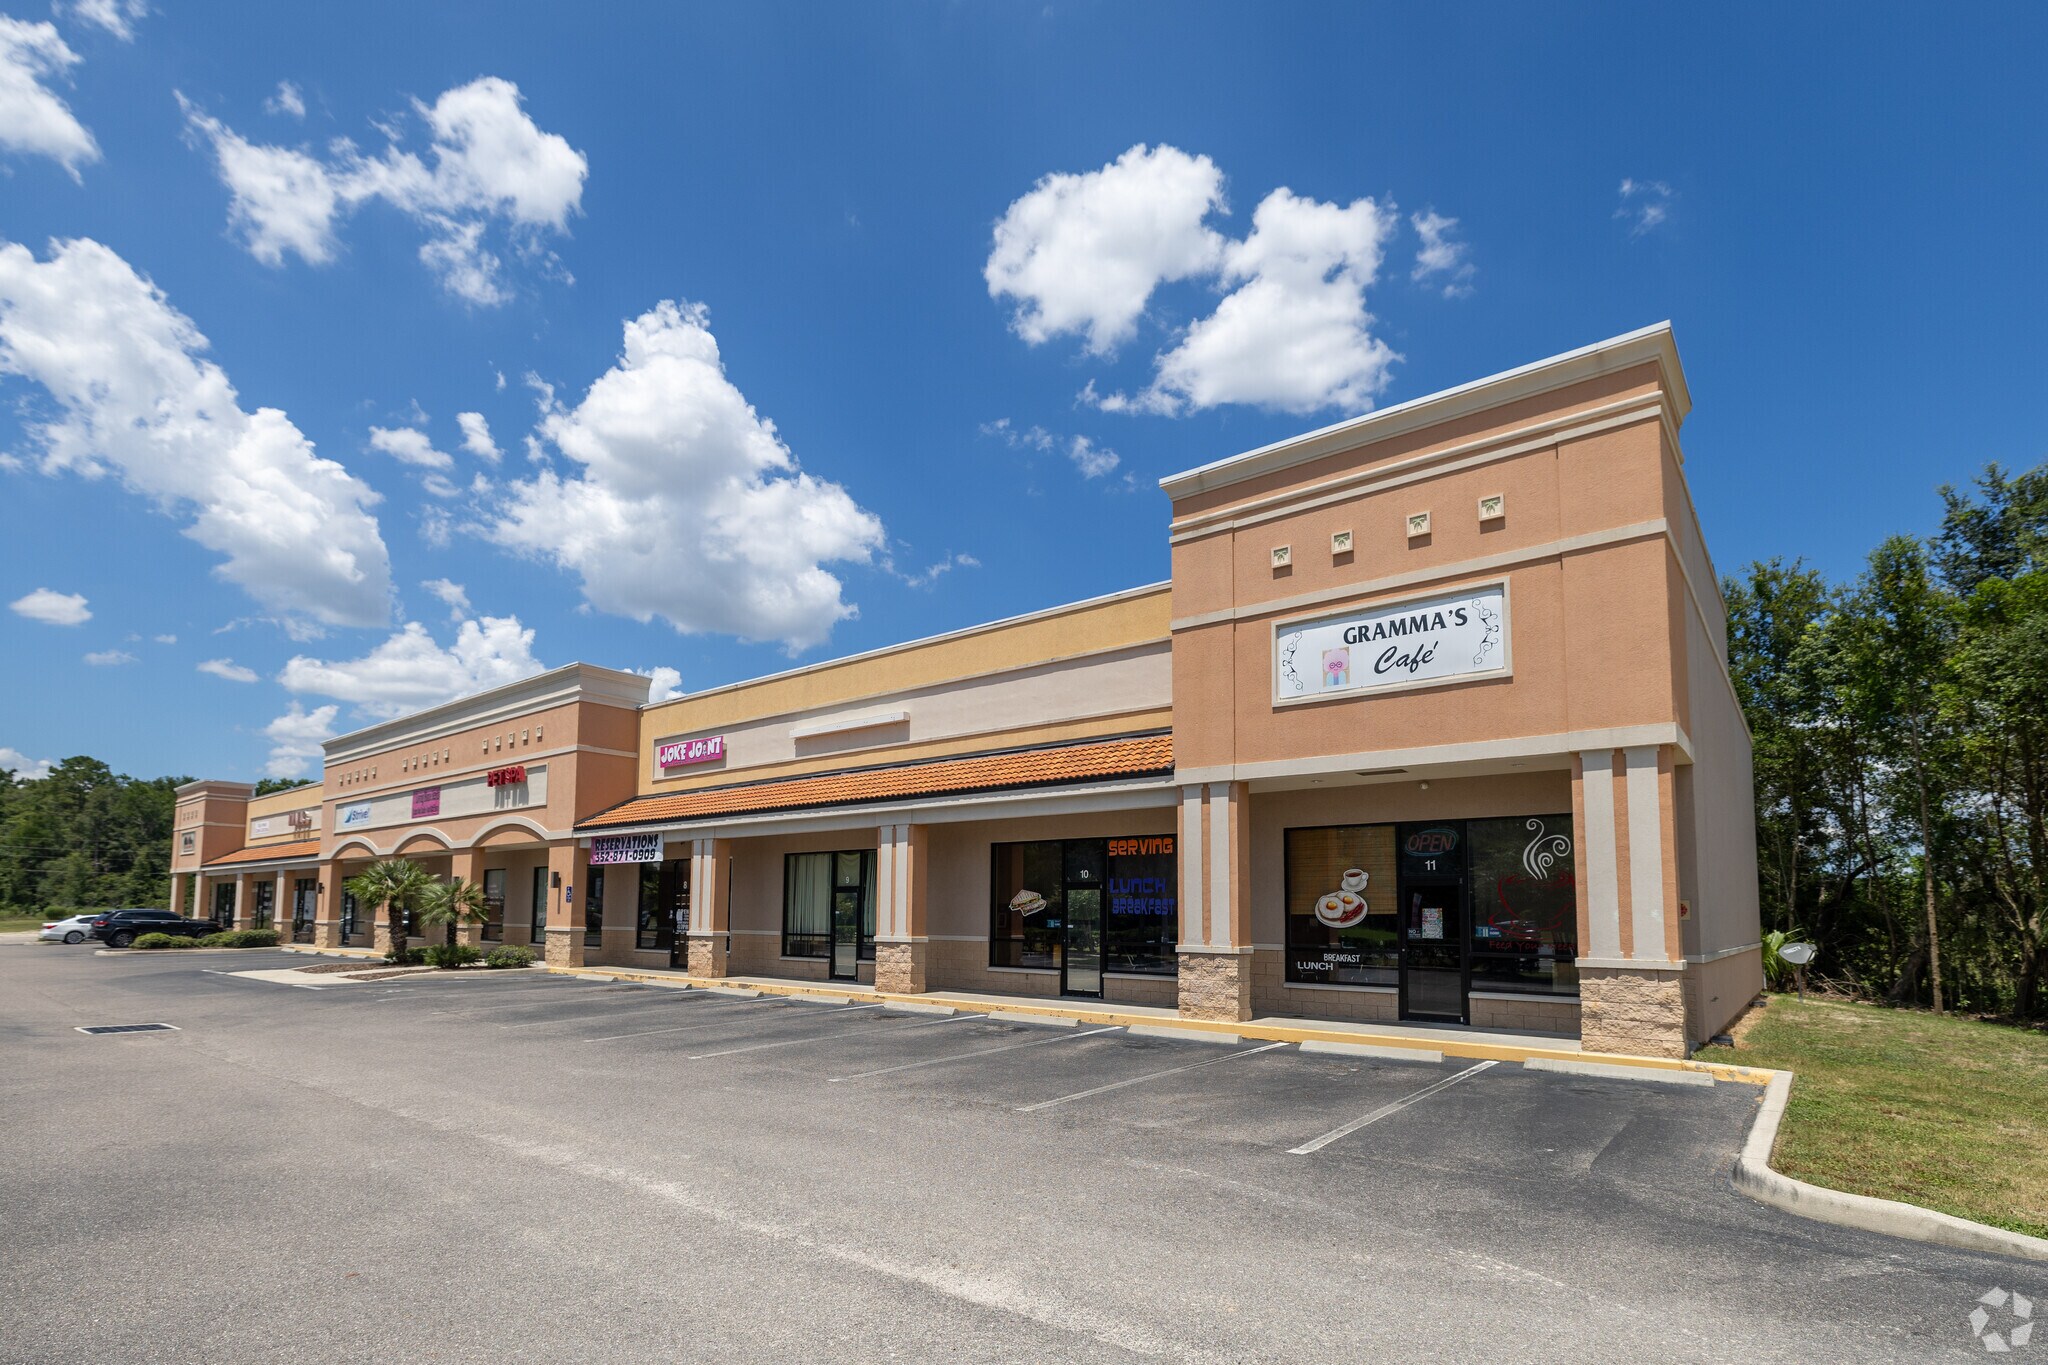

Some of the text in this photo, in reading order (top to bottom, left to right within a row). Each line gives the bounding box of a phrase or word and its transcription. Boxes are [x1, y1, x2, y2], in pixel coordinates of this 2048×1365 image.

[1343, 607, 1468, 645] GRAMMA'S
[1373, 641, 1439, 675] Café
[661, 744, 687, 763] JOKE
[595, 834, 659, 851] RESERVATIONS
[1108, 838, 1174, 856] SERVING
[1407, 834, 1453, 852] OPEN
[1425, 860, 1436, 871] 11
[845, 876, 850, 884] 9
[1080, 870, 1089, 879] 10
[683, 880, 688, 889] 8
[1109, 878, 1166, 894] LUNCH
[1112, 898, 1175, 915] BREAKFAST
[1297, 961, 1334, 970] LUNCH
[1323, 953, 1360, 963] BREAKFAST
